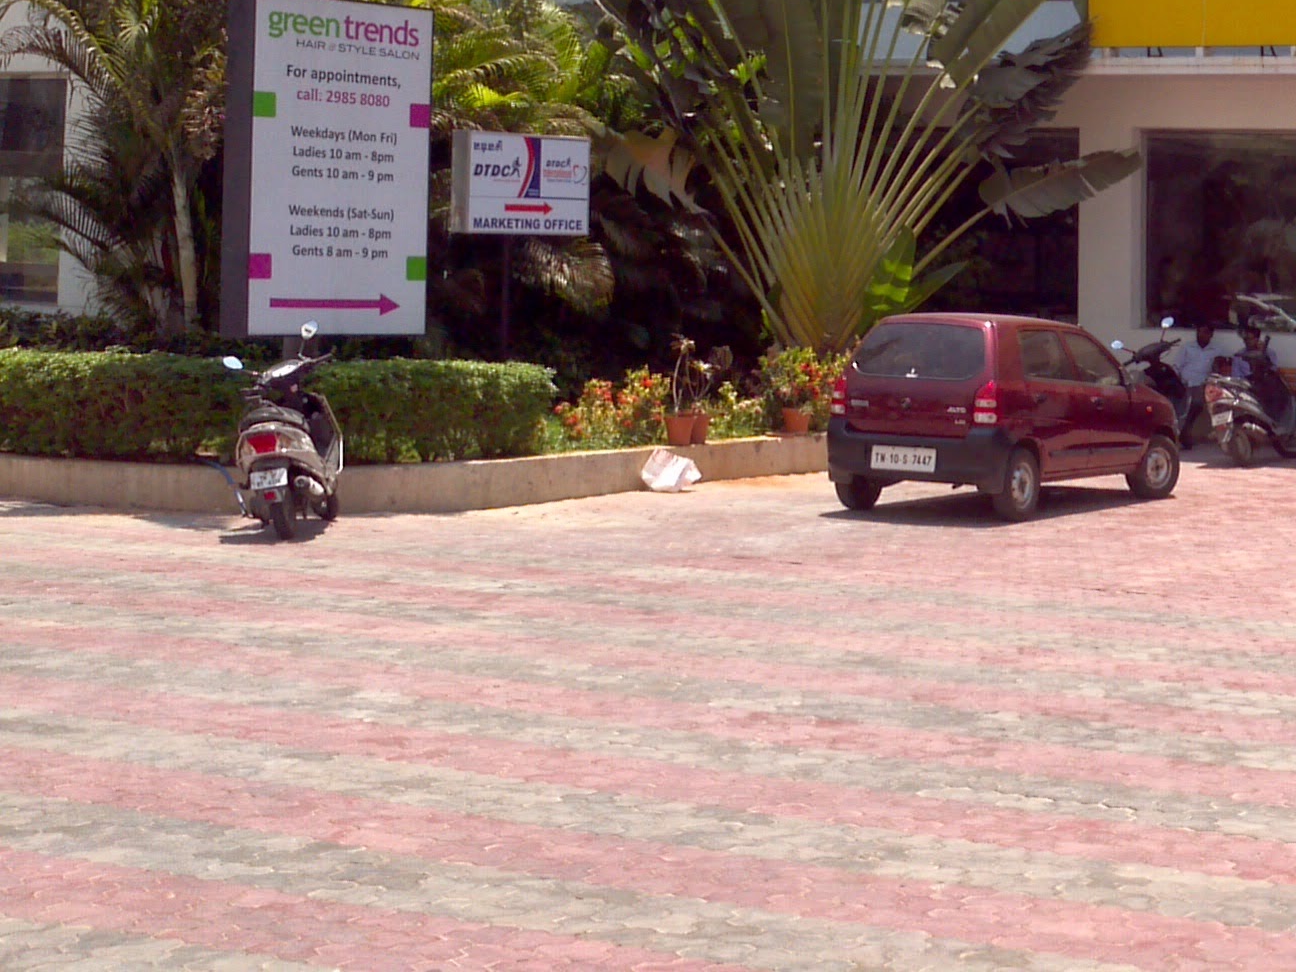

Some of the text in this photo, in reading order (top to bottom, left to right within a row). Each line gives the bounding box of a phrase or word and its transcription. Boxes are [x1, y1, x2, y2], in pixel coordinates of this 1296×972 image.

[268, 10, 419, 47] green trends
[296, 39, 326, 50] HAIR
[338, 44, 377, 56] STYLE
[379, 48, 420, 60] SALON
[286, 64, 401, 90] For appointments,
[296, 89, 390, 107] call: 2985 8080
[291, 125, 397, 146] Weekdays (Mon Fri)
[293, 146, 326, 159] Ladies
[330, 149, 343, 160] 10
[345, 152, 362, 161] am
[371, 151, 394, 164] 8pm
[292, 165, 323, 178] Gents
[327, 168, 339, 179] 10
[342, 171, 358, 180] am
[368, 170, 374, 180] 9
[377, 172, 394, 183] pm
[474, 163, 511, 177] DTDC
[289, 205, 395, 222] Weekends (Sat-Sun)
[290, 225, 323, 237] Ladies
[327, 227, 340, 238] 10
[342, 230, 359, 239] am
[368, 228, 391, 241] 8pm
[473, 218, 582, 230] MARKETING OFFICE
[292, 245, 323, 257] Gents
[327, 246, 333, 257] 8
[335, 249, 352, 258] am
[362, 247, 369, 258] 9
[371, 250, 388, 259] pm
